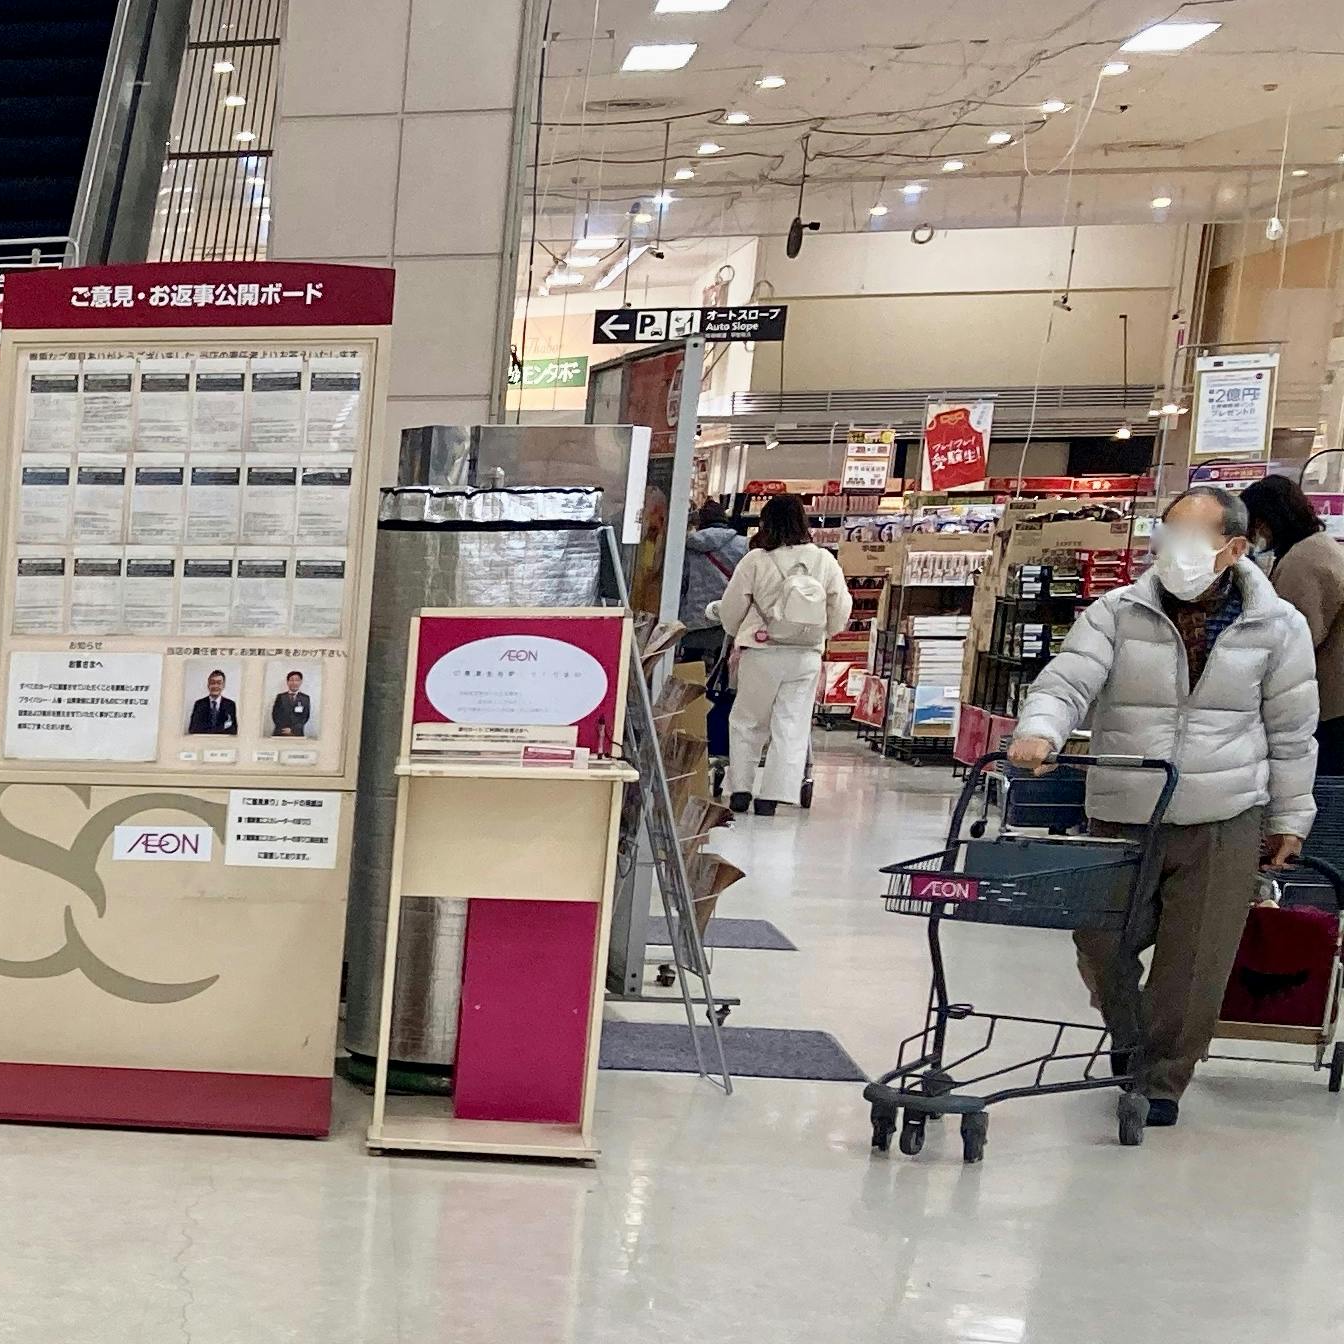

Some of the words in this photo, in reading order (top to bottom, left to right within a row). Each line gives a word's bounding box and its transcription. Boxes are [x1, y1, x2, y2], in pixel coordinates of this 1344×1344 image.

[70, 283, 324, 308] ご意見・お返事公開ボード
[706, 308, 781, 321] オートスロープ
[706, 322, 730, 332] Auto
[731, 322, 759, 333] Slope
[69, 641, 103, 650] お知らせ
